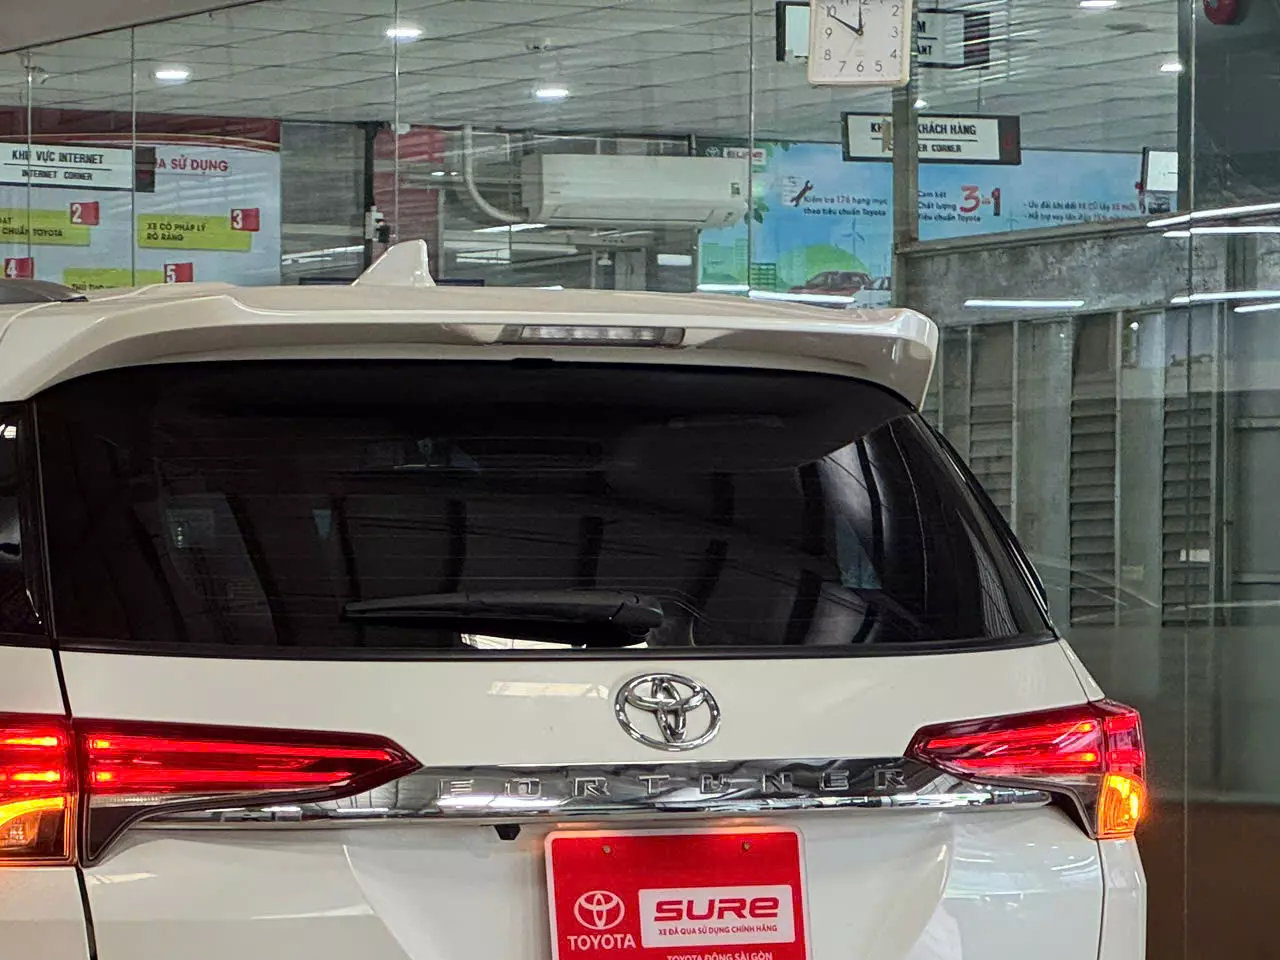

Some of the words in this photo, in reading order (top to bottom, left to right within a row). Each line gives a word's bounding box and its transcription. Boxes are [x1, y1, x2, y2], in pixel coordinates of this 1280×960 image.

[892, 5, 900, 17] 2
[825, 27, 833, 40] 9
[891, 26, 899, 39] 3
[823, 49, 832, 61] 8
[889, 48, 898, 60] 4
[839, 61, 847, 73] 7
[856, 61, 864, 73] 6
[874, 61, 883, 73] 5
[949, 120, 977, 136] HÀNG
[35, 150, 56, 164] VỰC
[58, 151, 104, 165] INTERNET
[190, 159, 229, 175] DỤNG
[72, 203, 83, 223] 2
[232, 209, 243, 229] 3
[32, 228, 63, 237] TOYOTA
[437, 767, 907, 799] FORTUNER
[658, 928, 667, 936] XE
[680, 927, 697, 935] QUA
[708, 926, 730, 937] DỤNG
[731, 925, 755, 934] CHÍNH
[566, 933, 637, 951] TOYOTA
